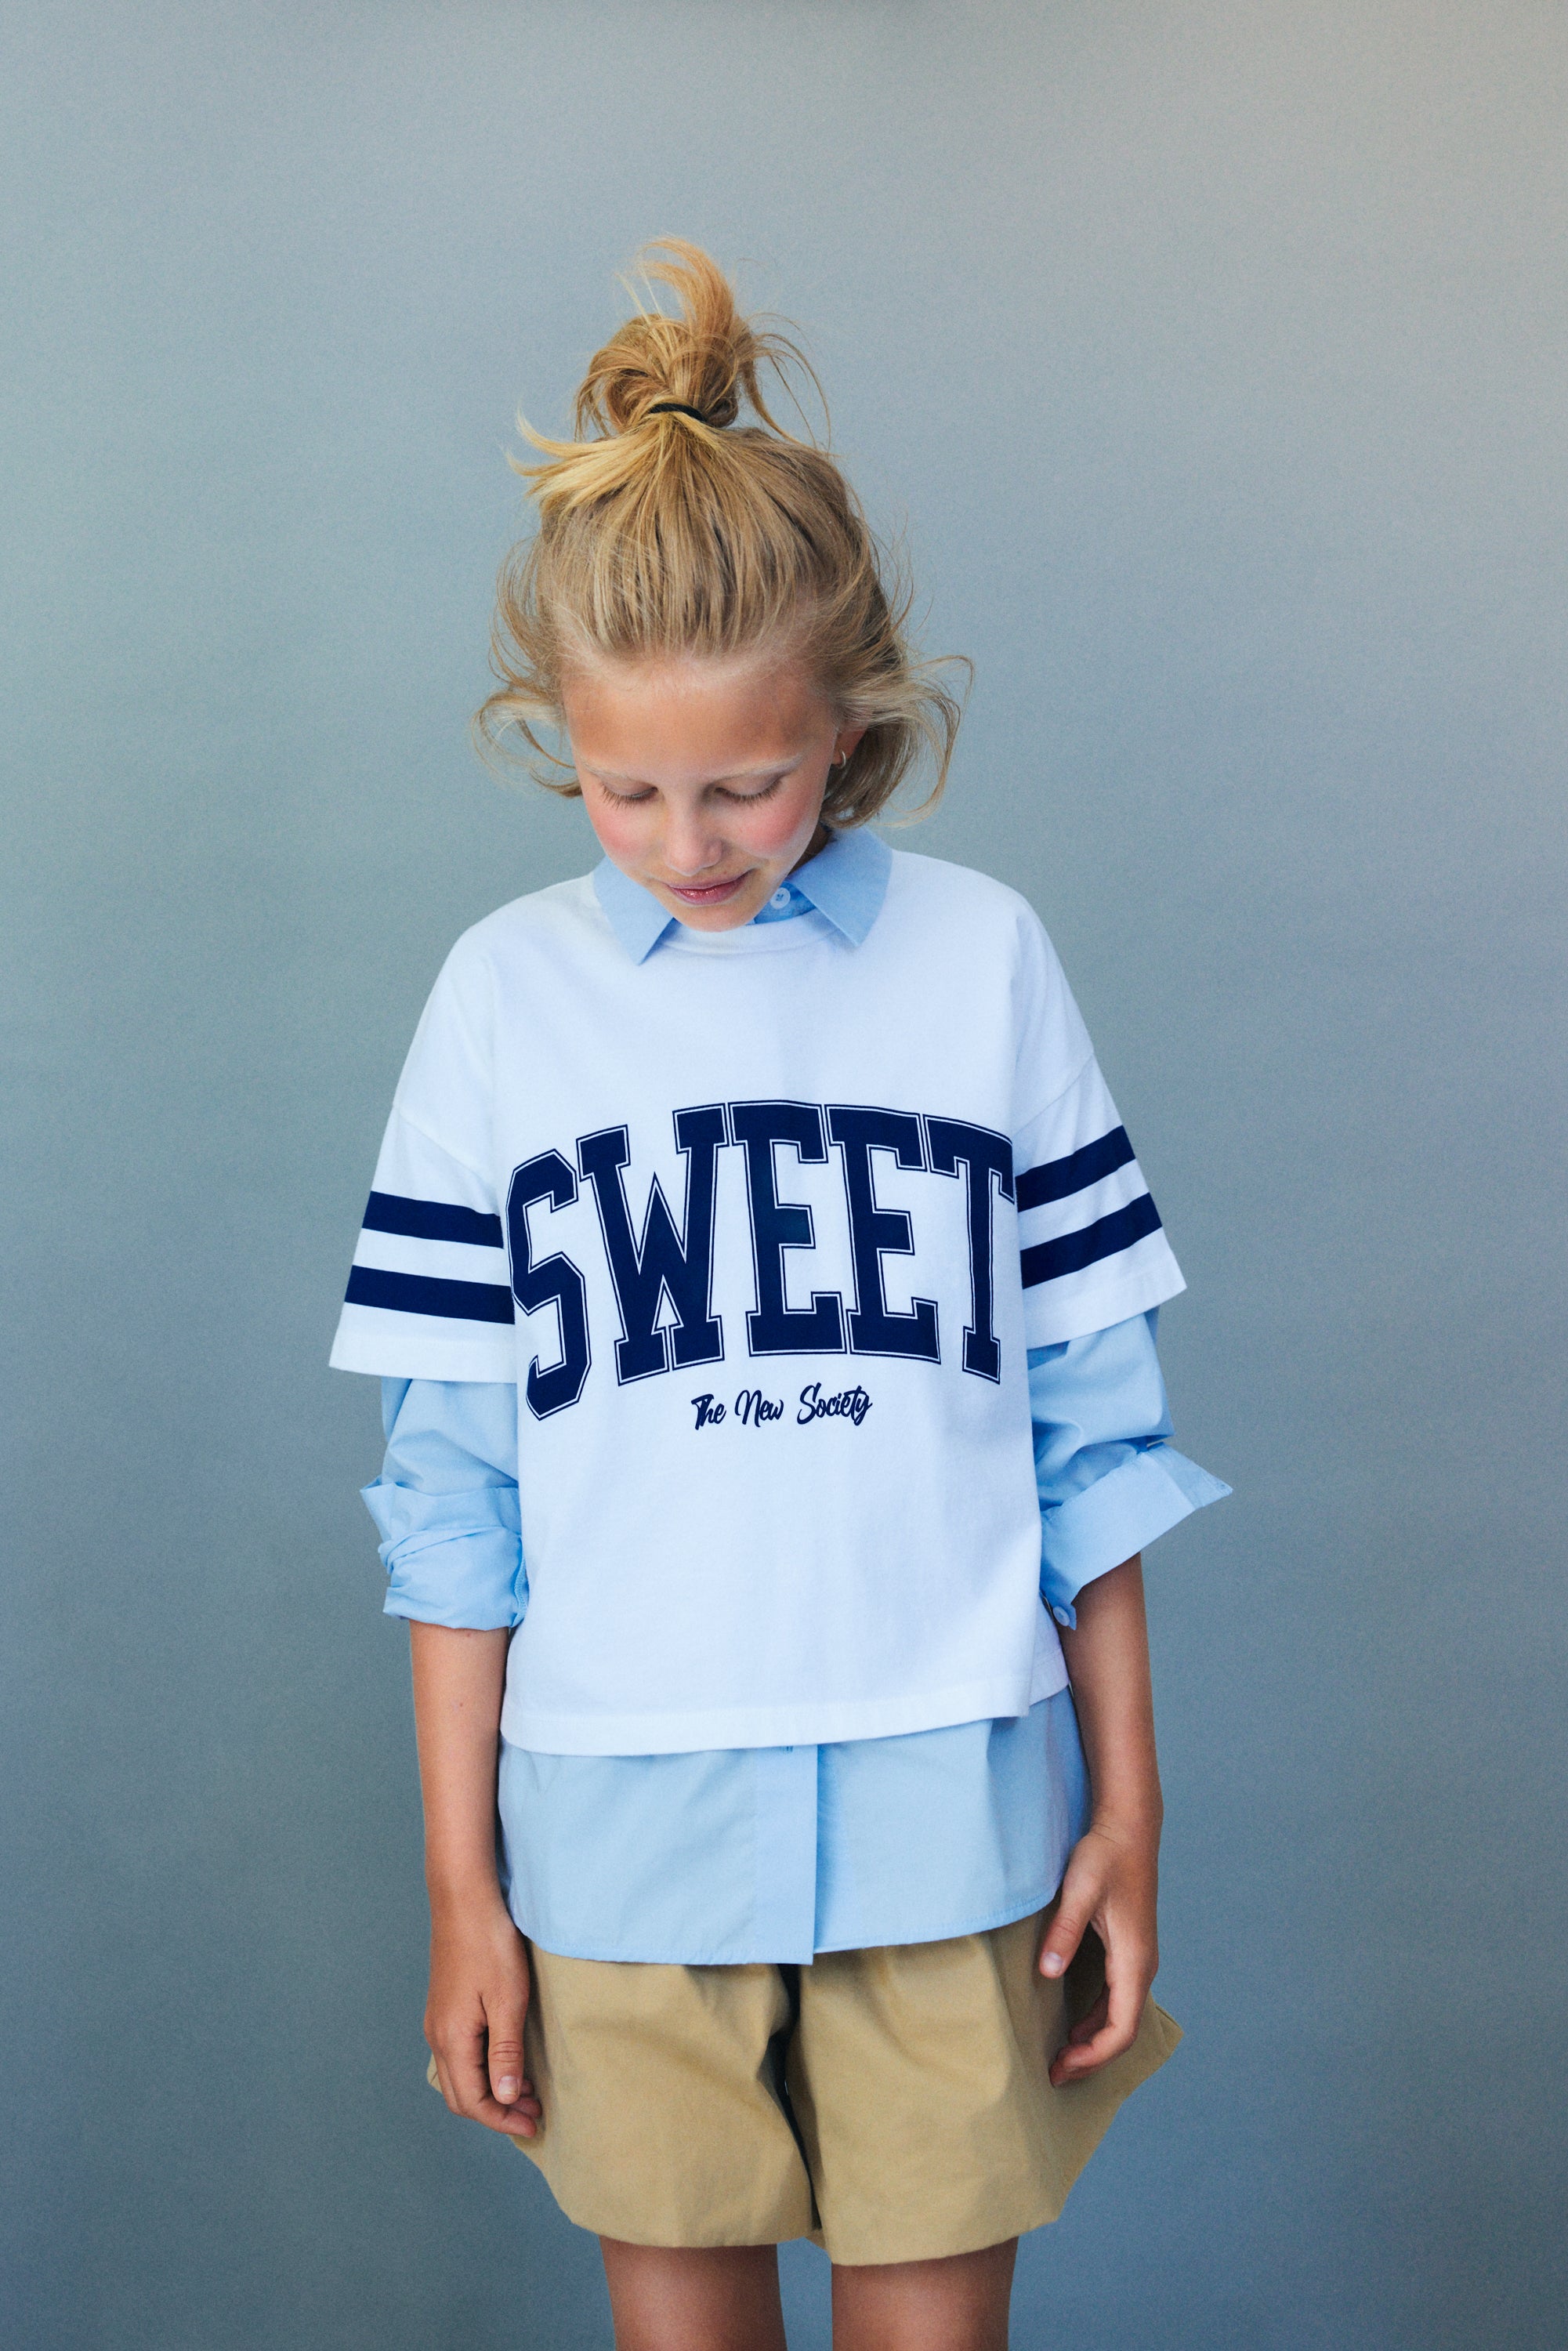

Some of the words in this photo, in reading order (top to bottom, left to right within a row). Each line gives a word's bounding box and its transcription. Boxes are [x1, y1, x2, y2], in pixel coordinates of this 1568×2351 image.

[506, 1099, 1015, 1422] SWEET
[690, 1393, 727, 1430] The
[734, 1389, 784, 1428] New
[796, 1382, 873, 1426] Society
